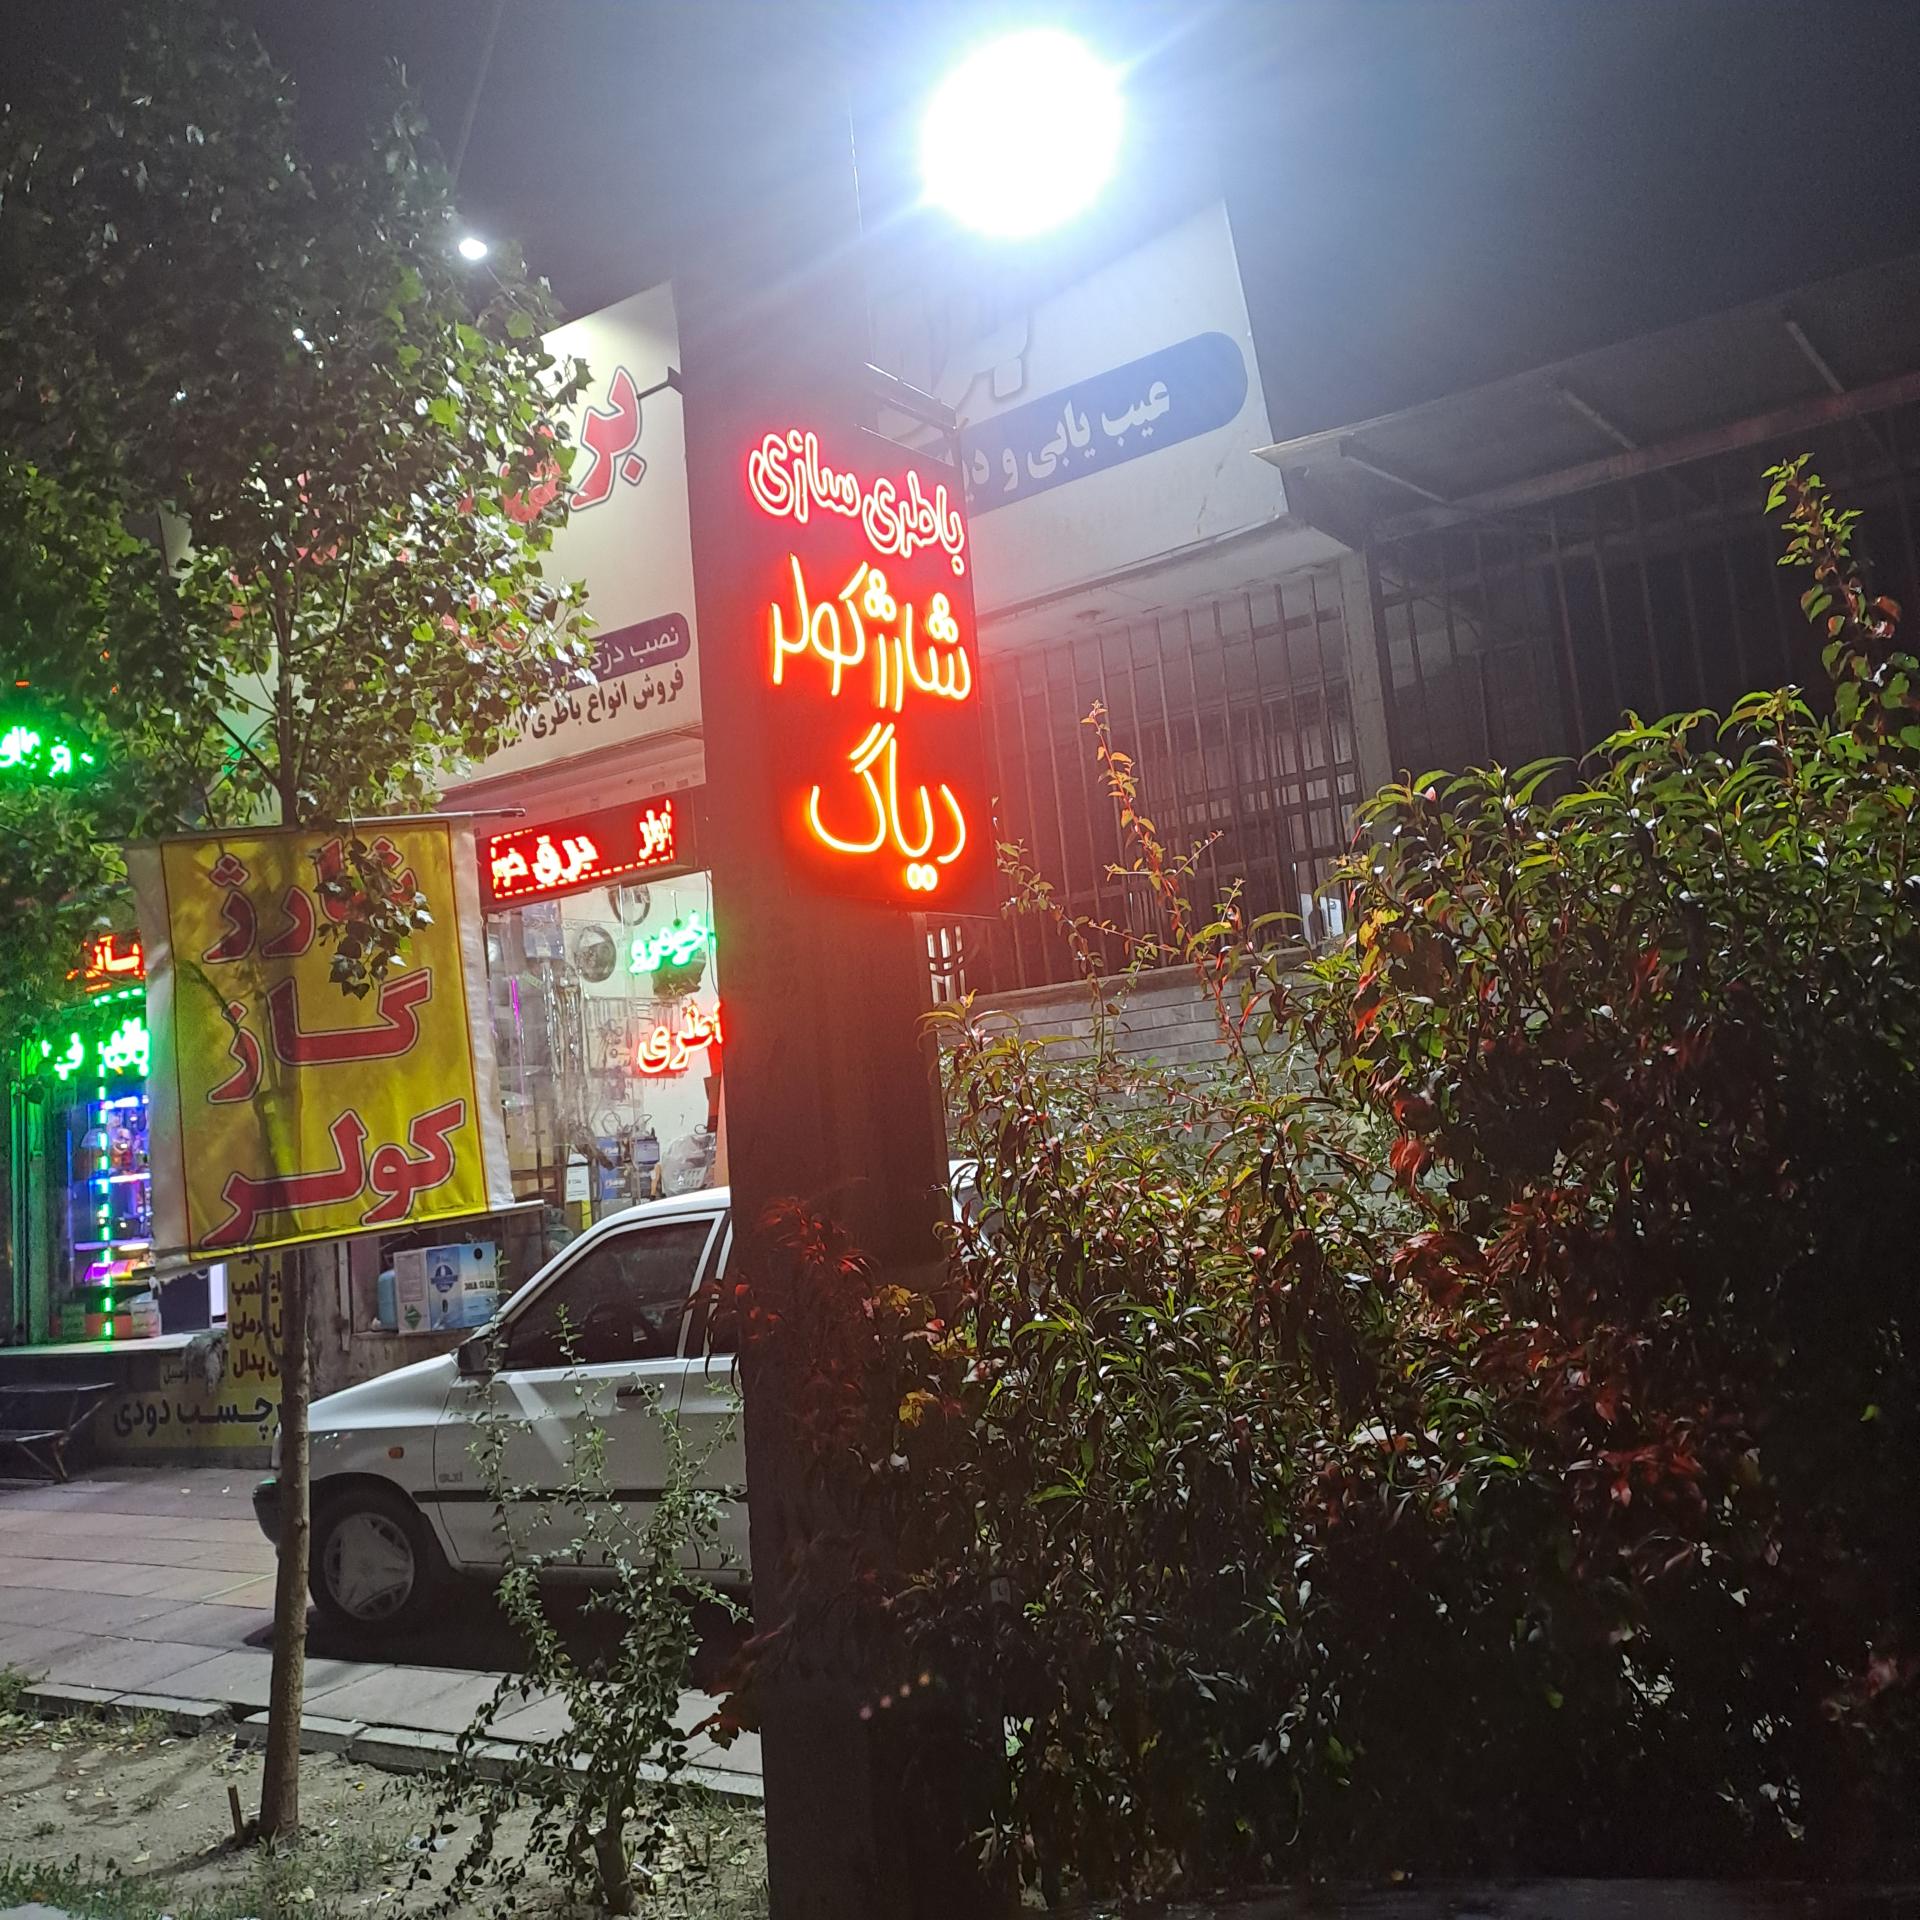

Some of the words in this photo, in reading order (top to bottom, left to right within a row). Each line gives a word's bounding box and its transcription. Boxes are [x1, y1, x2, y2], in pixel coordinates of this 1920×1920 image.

[1027, 400, 1096, 479] یابی
[1101, 381, 1170, 446] عیب
[748, 429, 861, 524] سازی
[1003, 447, 1019, 492] و
[862, 470, 967, 576] باطری
[630, 626, 680, 663] نصب
[770, 551, 867, 698] کولر
[865, 569, 972, 714] شارژ
[531, 695, 582, 738] باطری
[587, 680, 628, 723] انواع
[633, 663, 684, 710] فروش
[809, 721, 968, 893] دیاگ
[208, 968, 432, 1104] گاز
[201, 1099, 465, 1248] کولر
[114, 1399, 171, 1437] دودی
[177, 1397, 272, 1441] چسب
